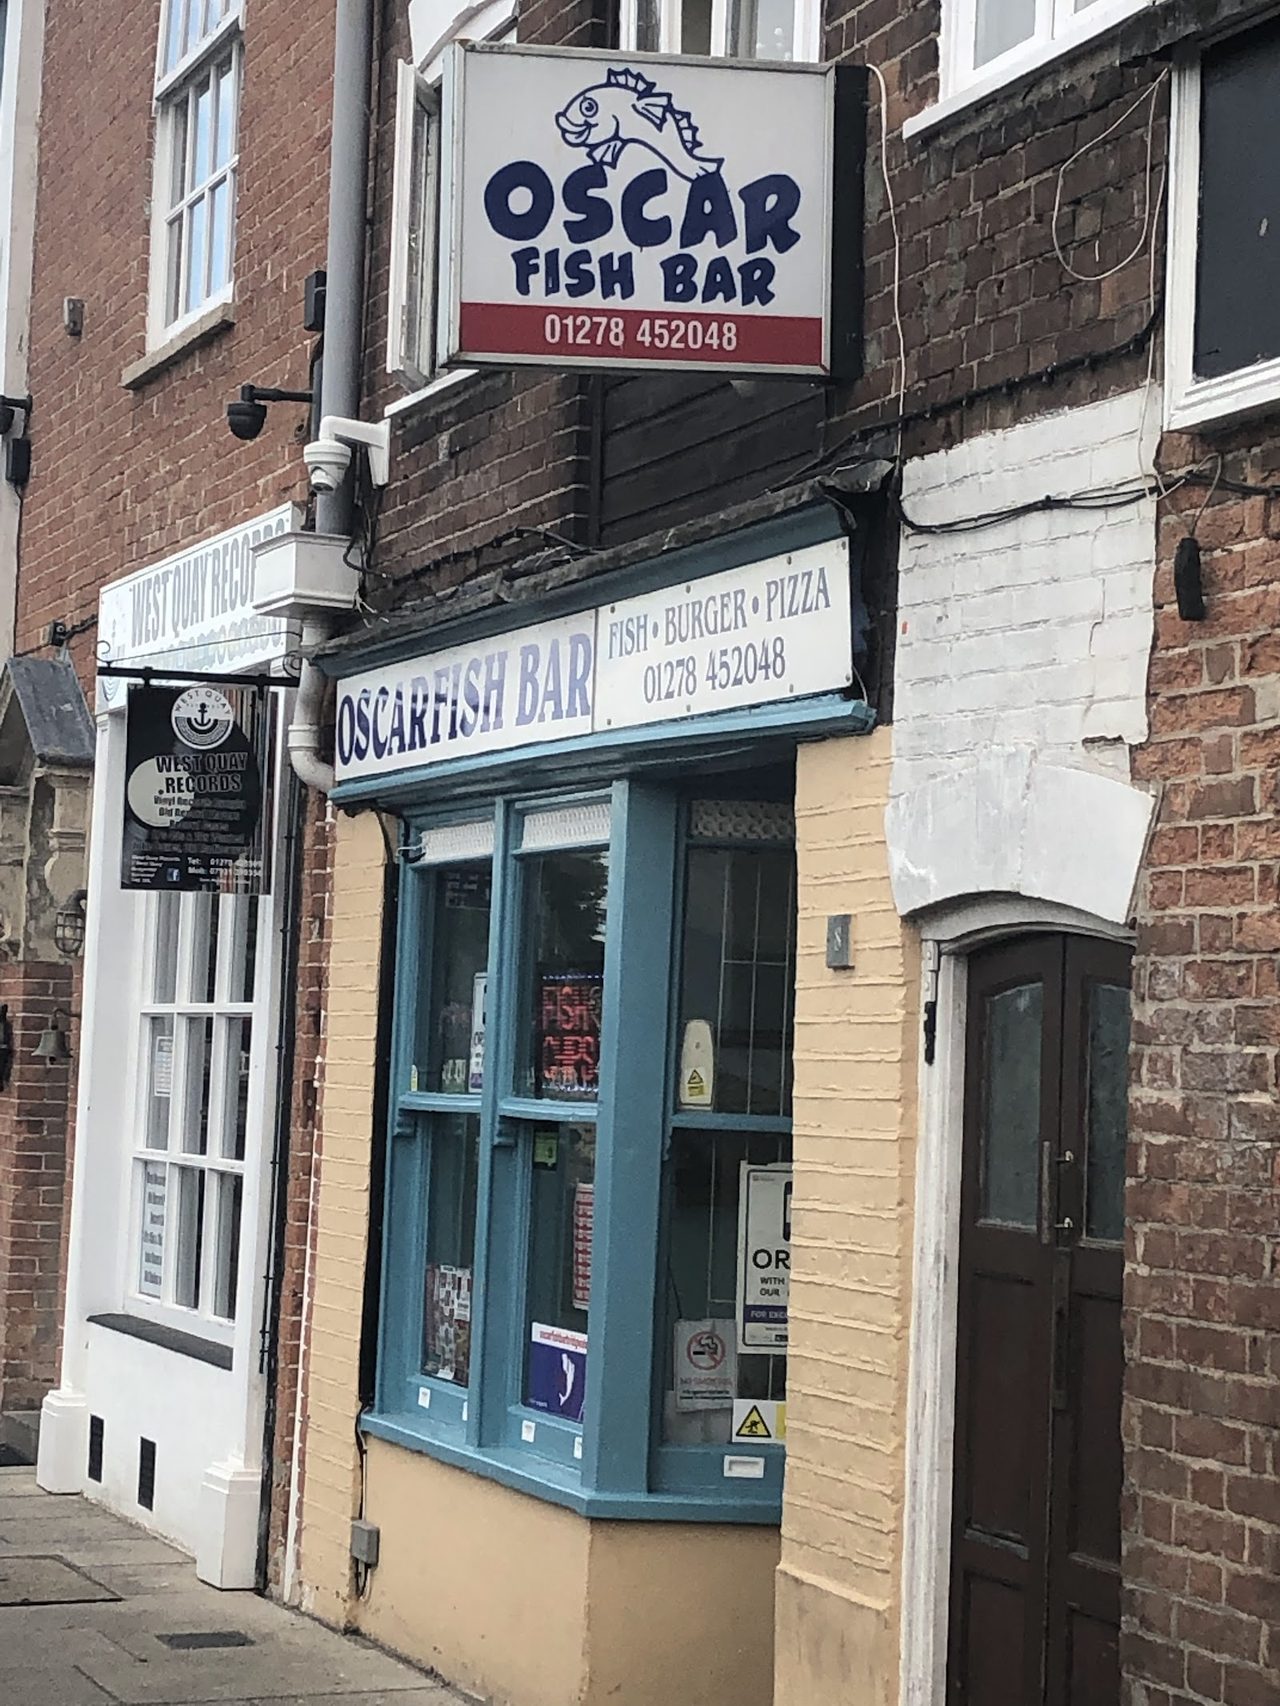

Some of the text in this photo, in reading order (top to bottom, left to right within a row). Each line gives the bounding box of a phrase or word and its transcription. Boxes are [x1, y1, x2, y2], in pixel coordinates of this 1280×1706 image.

[484, 160, 801, 254] OSCAR
[511, 246, 776, 306] FISH BAR
[544, 314, 737, 351] 01278 452048
[132, 518, 285, 648] WEST QUAY RECO
[608, 566, 831, 660] FISH BURGER PIZZA
[515, 632, 592, 728] BAR
[644, 636, 786, 704] 01278 452048
[175, 690, 231, 715] WEST QUAY
[155, 752, 248, 774] WEST QUAY
[165, 774, 241, 794] RECORDS
[759, 1287, 780, 1297] OUR
[760, 1276, 785, 1286] WITH
